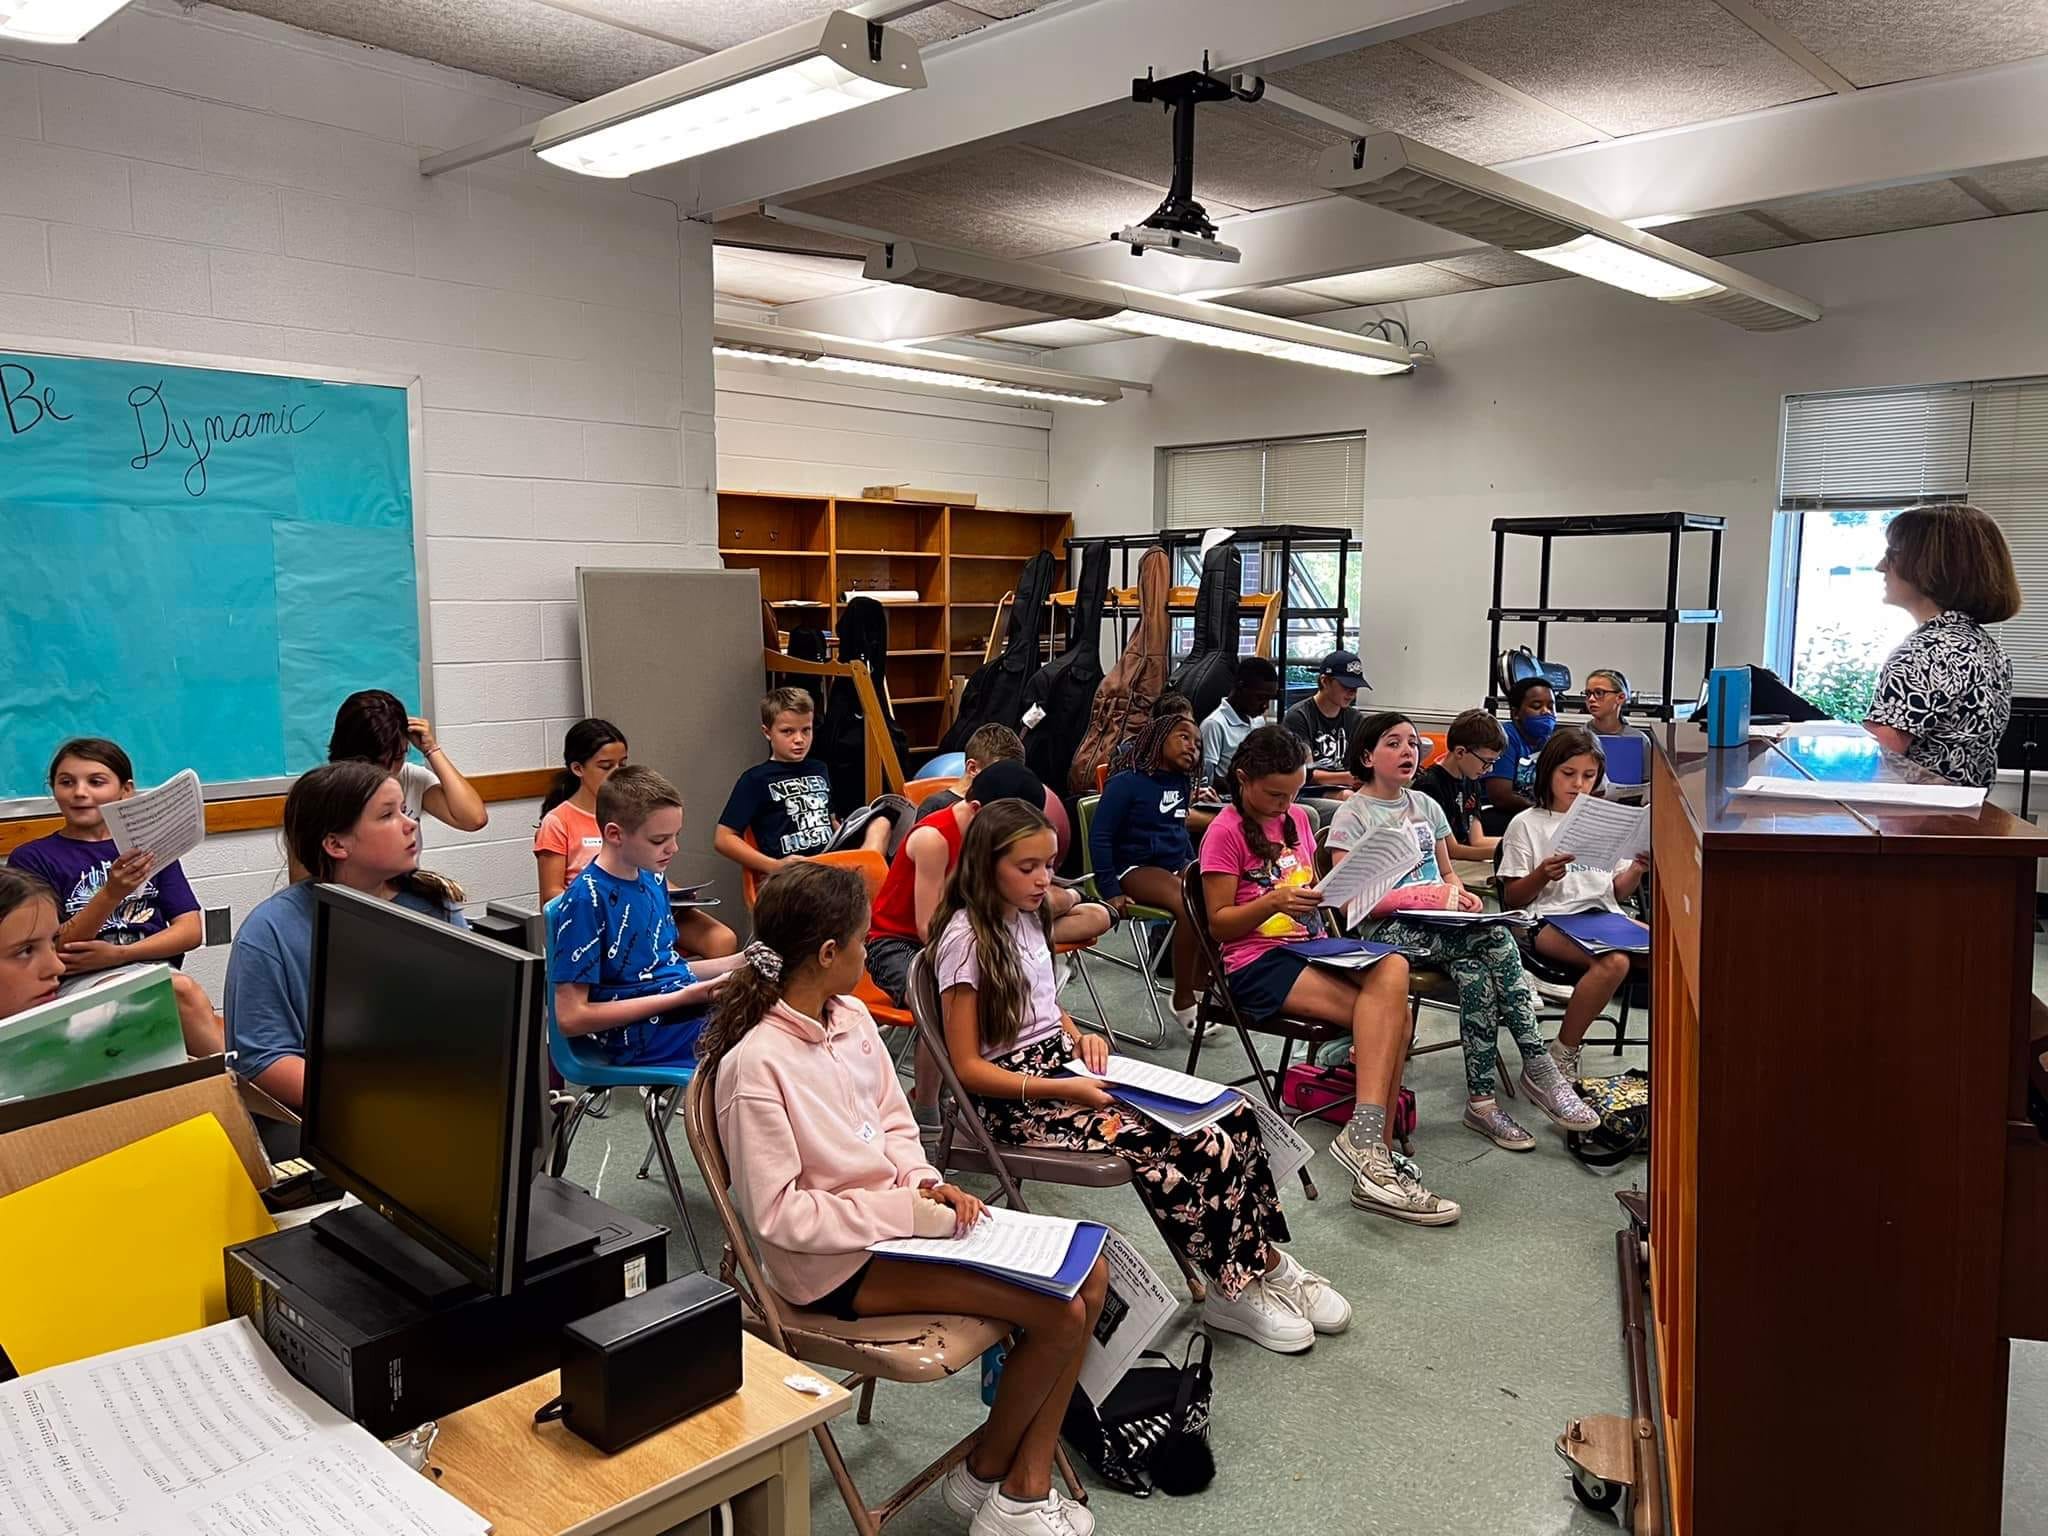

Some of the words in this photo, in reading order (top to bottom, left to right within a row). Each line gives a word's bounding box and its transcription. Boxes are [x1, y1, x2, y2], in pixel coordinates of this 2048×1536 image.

[0, 364, 73, 434] Be
[128, 380, 325, 496] Dynamic
[768, 775, 829, 801] NEVER
[1163, 790, 1180, 803] NIKE
[785, 792, 829, 815] STOP
[792, 808, 831, 831] THE
[1113, 1240, 1137, 1268] Comes
[1137, 1268, 1150, 1284] the
[1150, 1284, 1164, 1303] Sun
